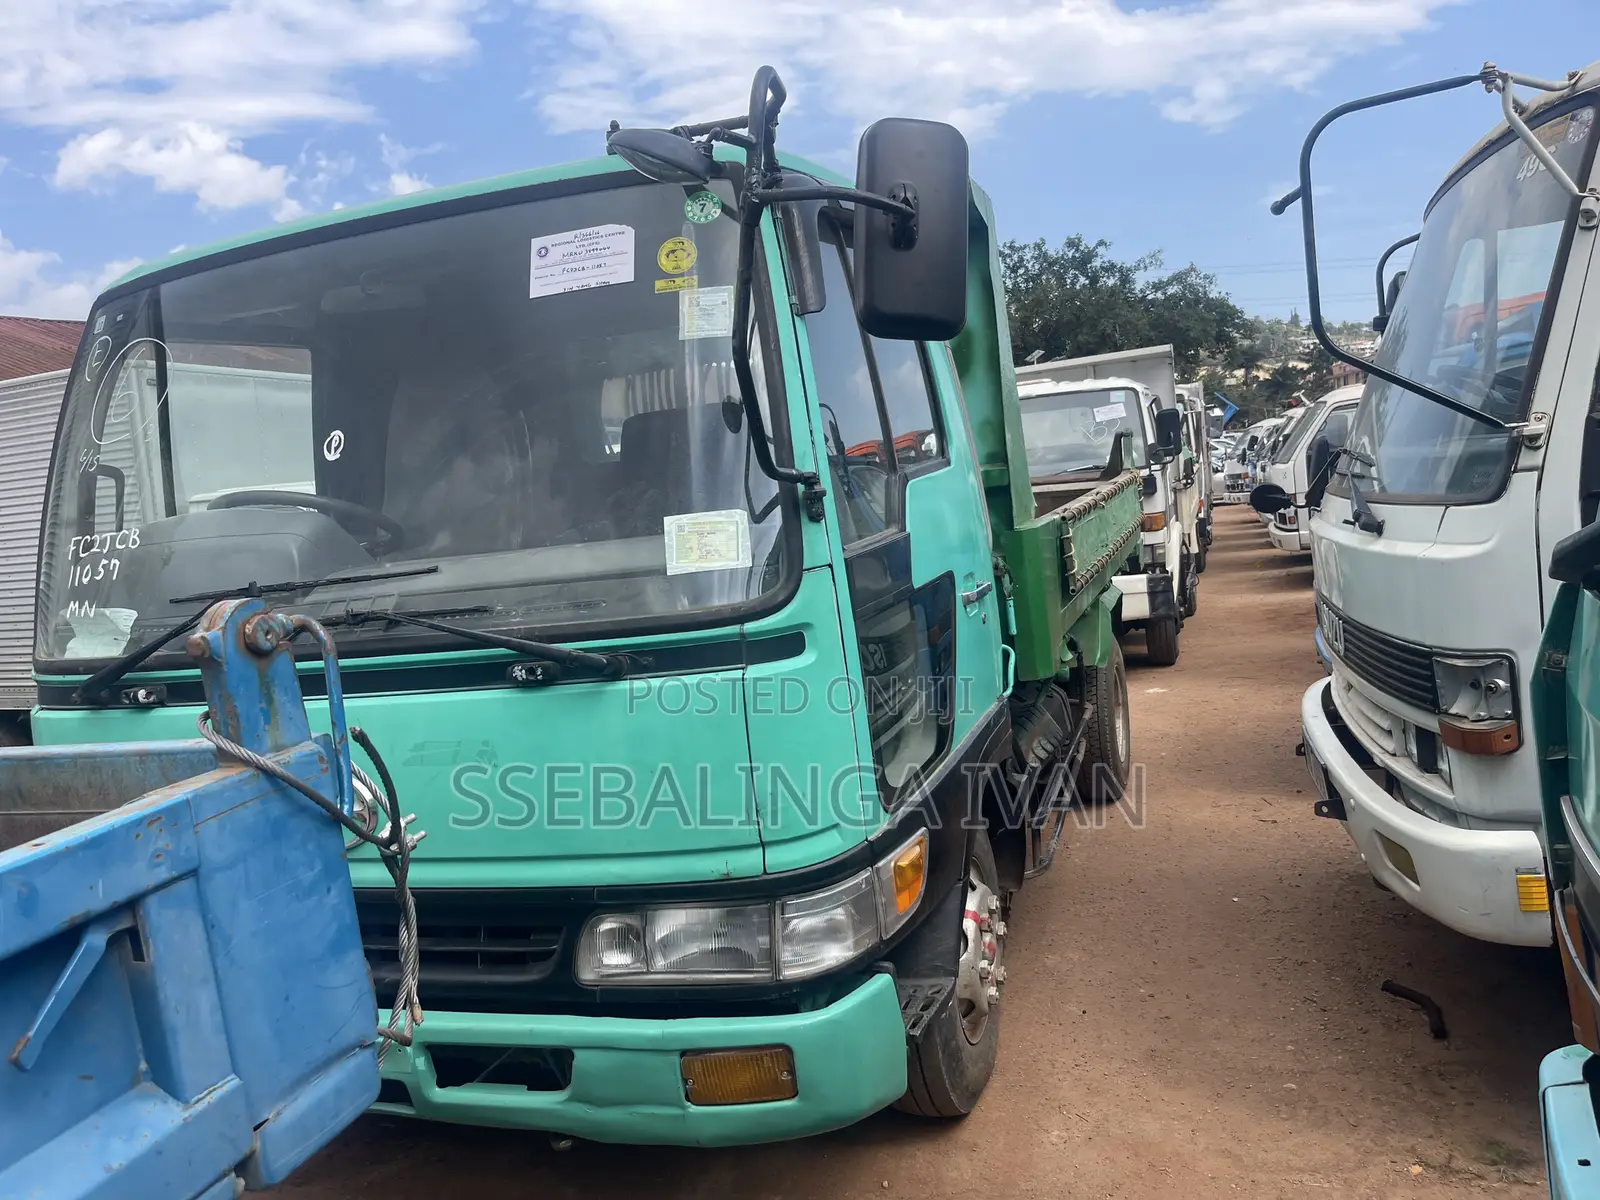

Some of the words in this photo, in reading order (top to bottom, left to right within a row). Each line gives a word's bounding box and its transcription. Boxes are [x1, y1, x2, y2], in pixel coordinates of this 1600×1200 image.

[699, 203, 706, 213] 7
[551, 239, 576, 248] REGIONAL
[67, 527, 141, 560] FC2JCB
[67, 557, 120, 590] 11057
[66, 600, 97, 619] MN
